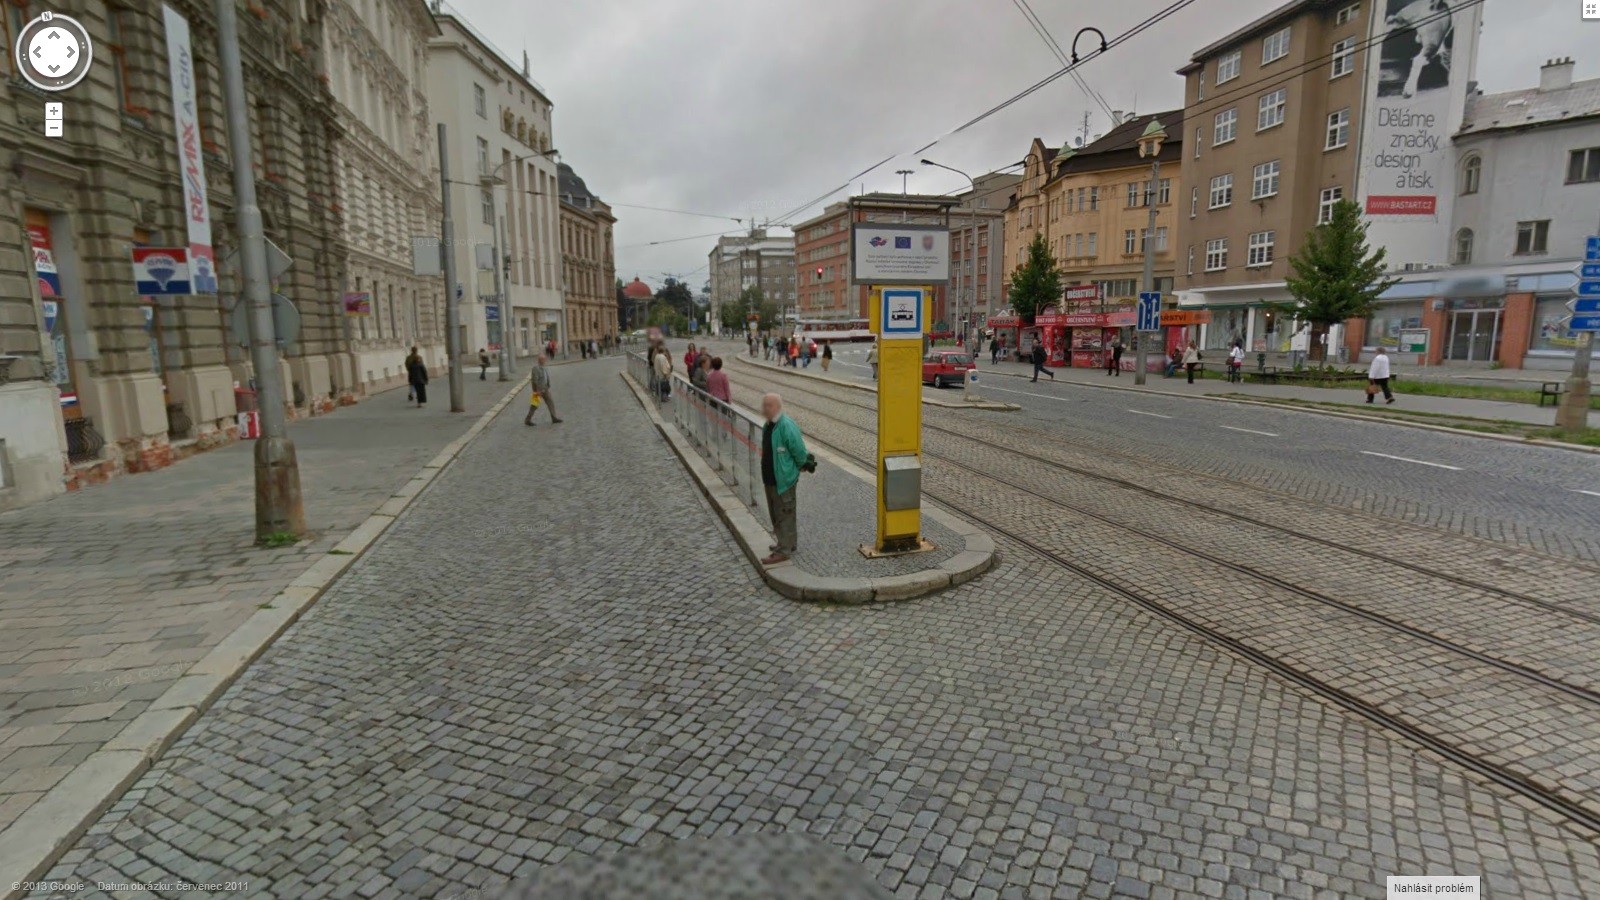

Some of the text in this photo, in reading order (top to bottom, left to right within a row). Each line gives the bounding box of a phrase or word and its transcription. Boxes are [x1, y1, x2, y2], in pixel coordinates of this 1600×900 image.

[1378, 107, 1435, 128] Děláme
[1390, 129, 1440, 153] značky,
[180, 118, 206, 223] RE/MAX
[1374, 149, 1421, 174] design
[1395, 170, 1434, 189] a tisk.
